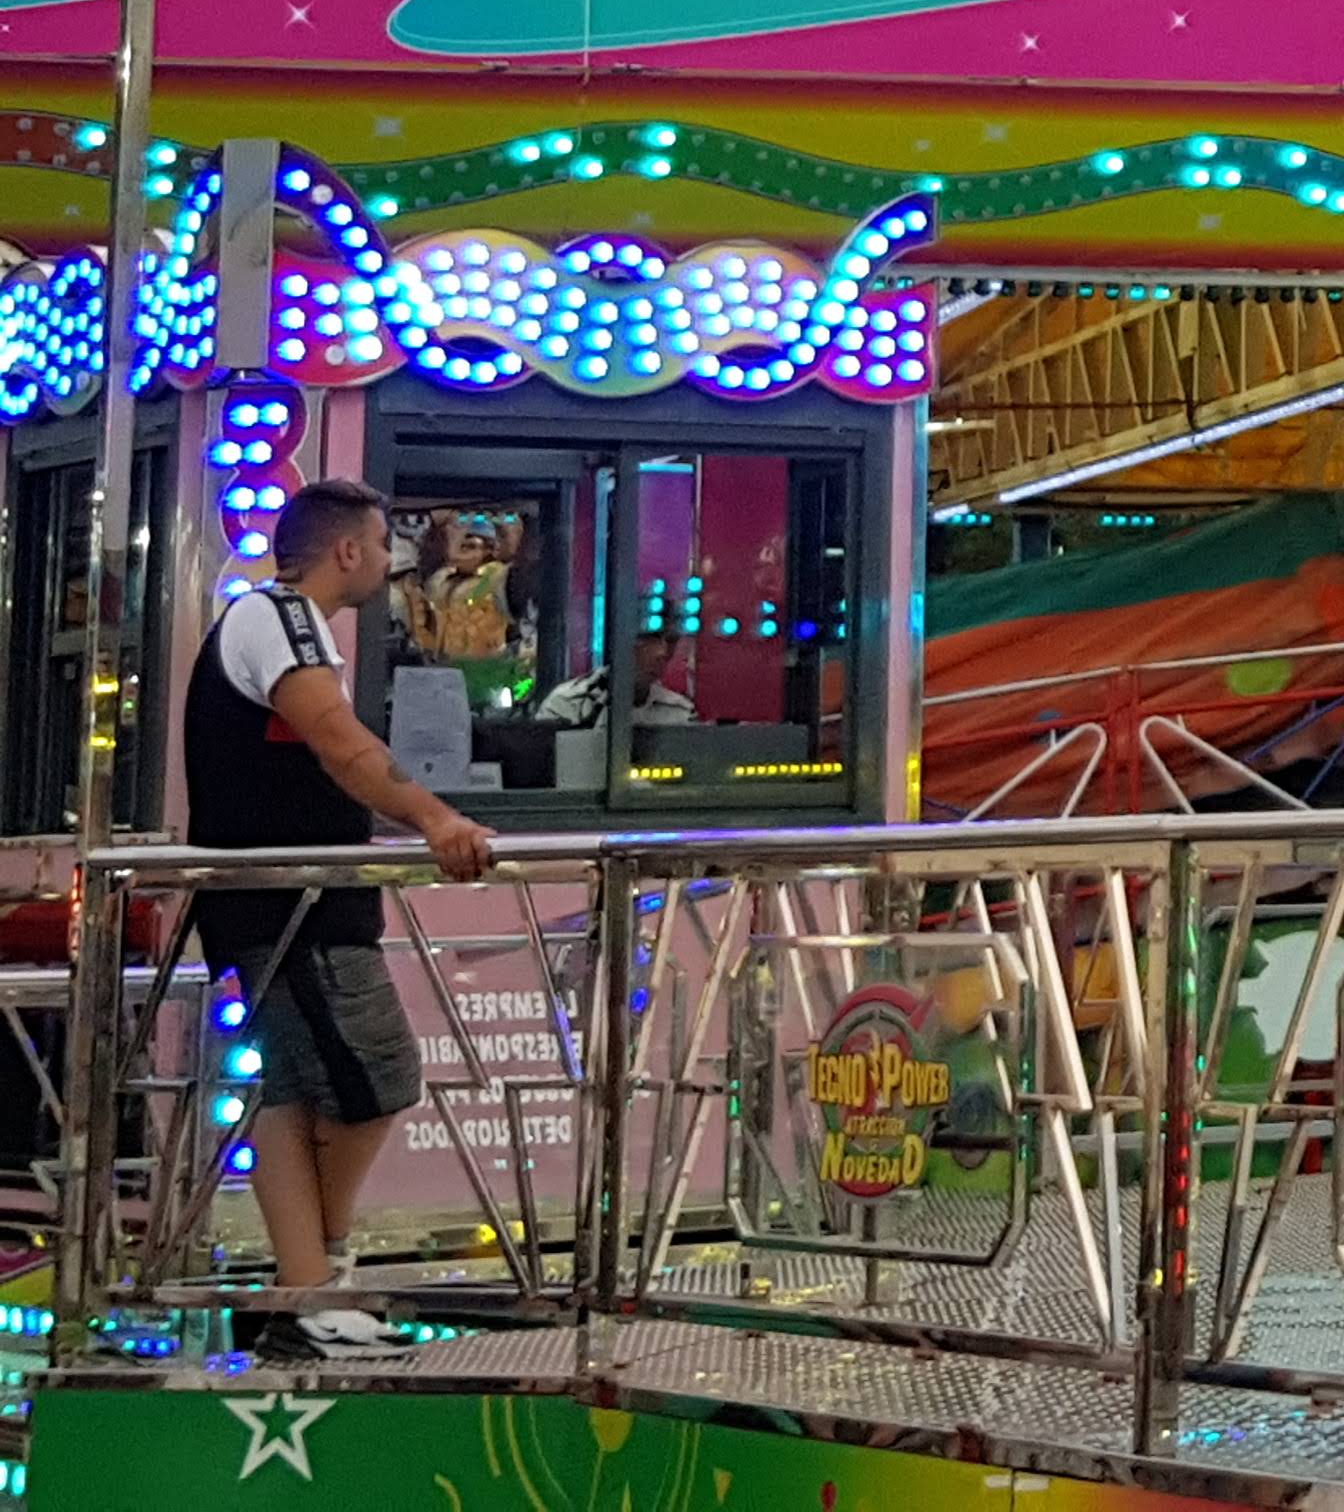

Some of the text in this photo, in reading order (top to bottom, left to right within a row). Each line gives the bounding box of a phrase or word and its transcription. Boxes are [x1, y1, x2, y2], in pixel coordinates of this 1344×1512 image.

[808, 1041, 950, 1109] TECNO POWER
[821, 1134, 925, 1185] NOVEDAD
